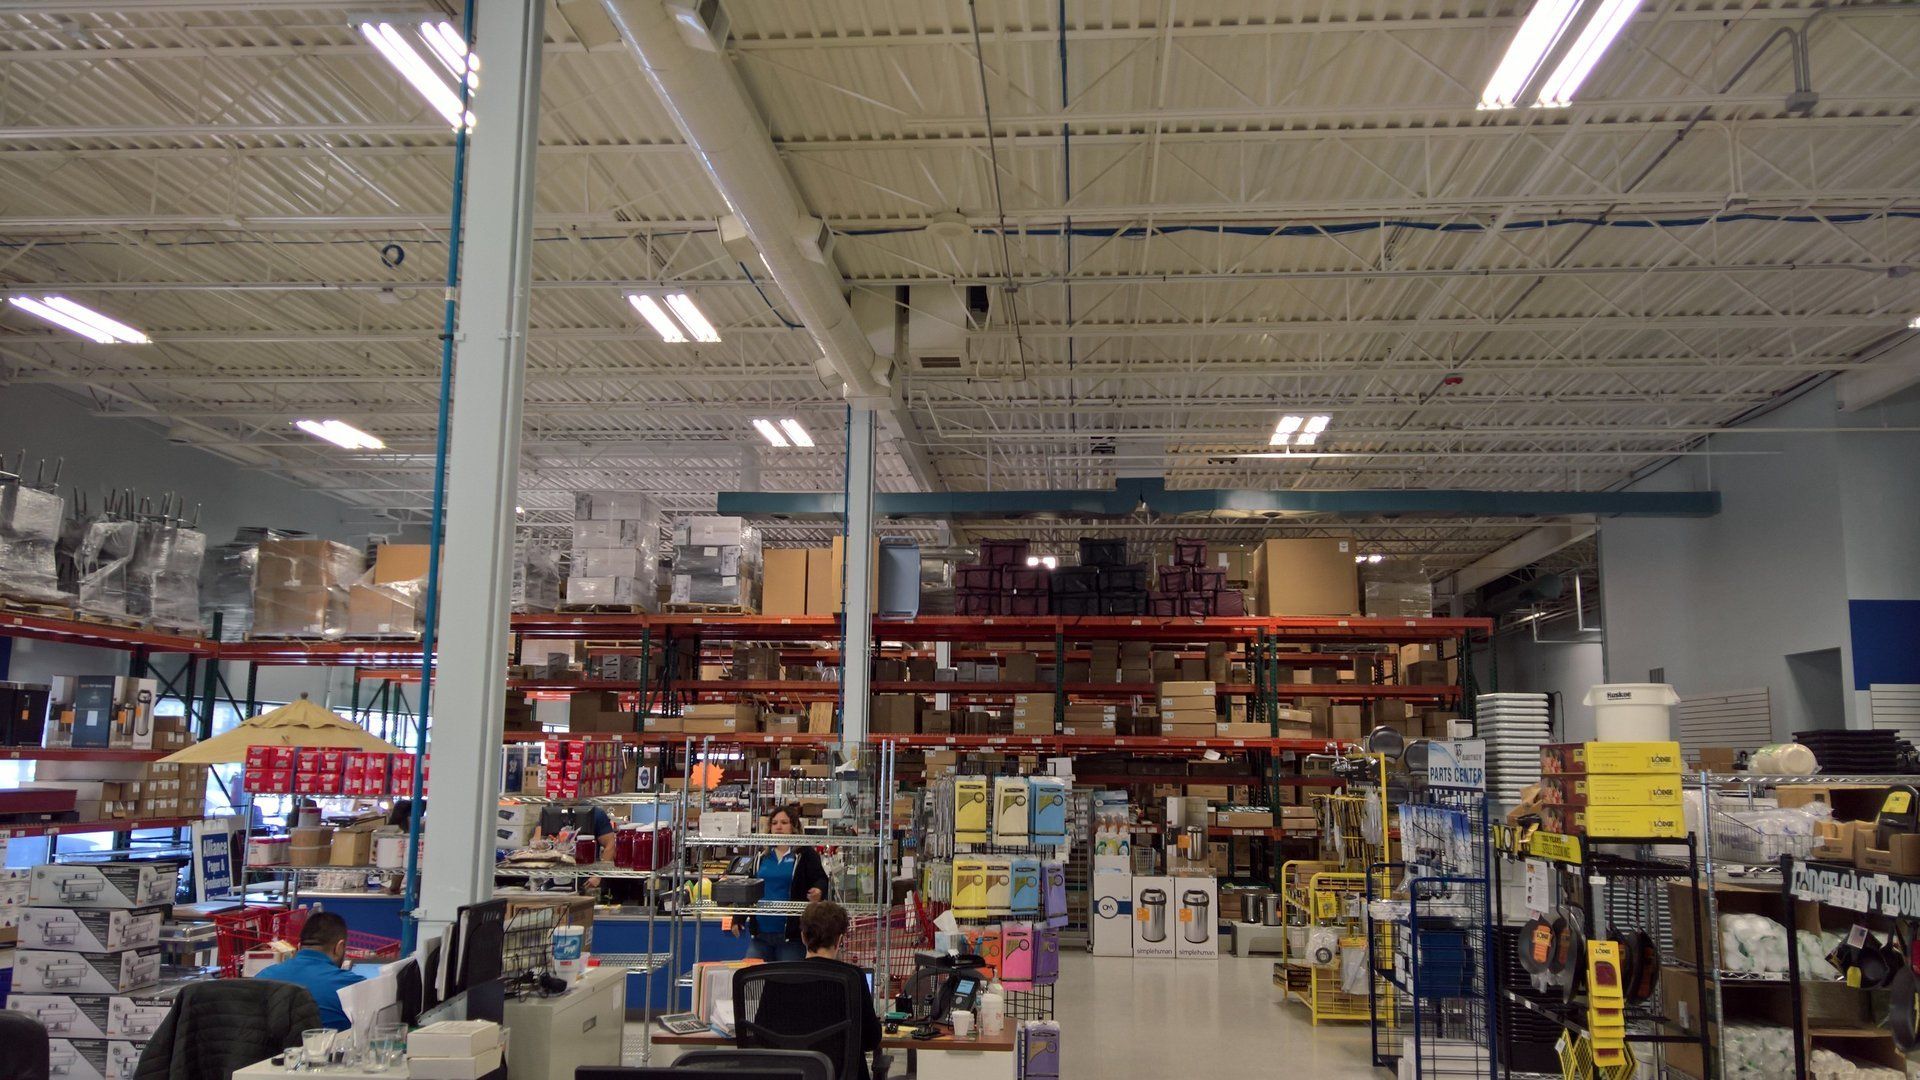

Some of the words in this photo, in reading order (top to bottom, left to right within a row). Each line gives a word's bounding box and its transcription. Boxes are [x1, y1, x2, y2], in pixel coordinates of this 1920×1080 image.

[1651, 755, 1672, 763] LODGE
[1430, 766, 1452, 782] PARTS
[1454, 767, 1483, 784] CENTER
[1652, 788, 1673, 796] LODGE
[1653, 820, 1674, 828] LODGE
[203, 839, 228, 857] Alliance
[1137, 948, 1173, 956] simplehuman
[1179, 949, 1215, 957] simplehuman
